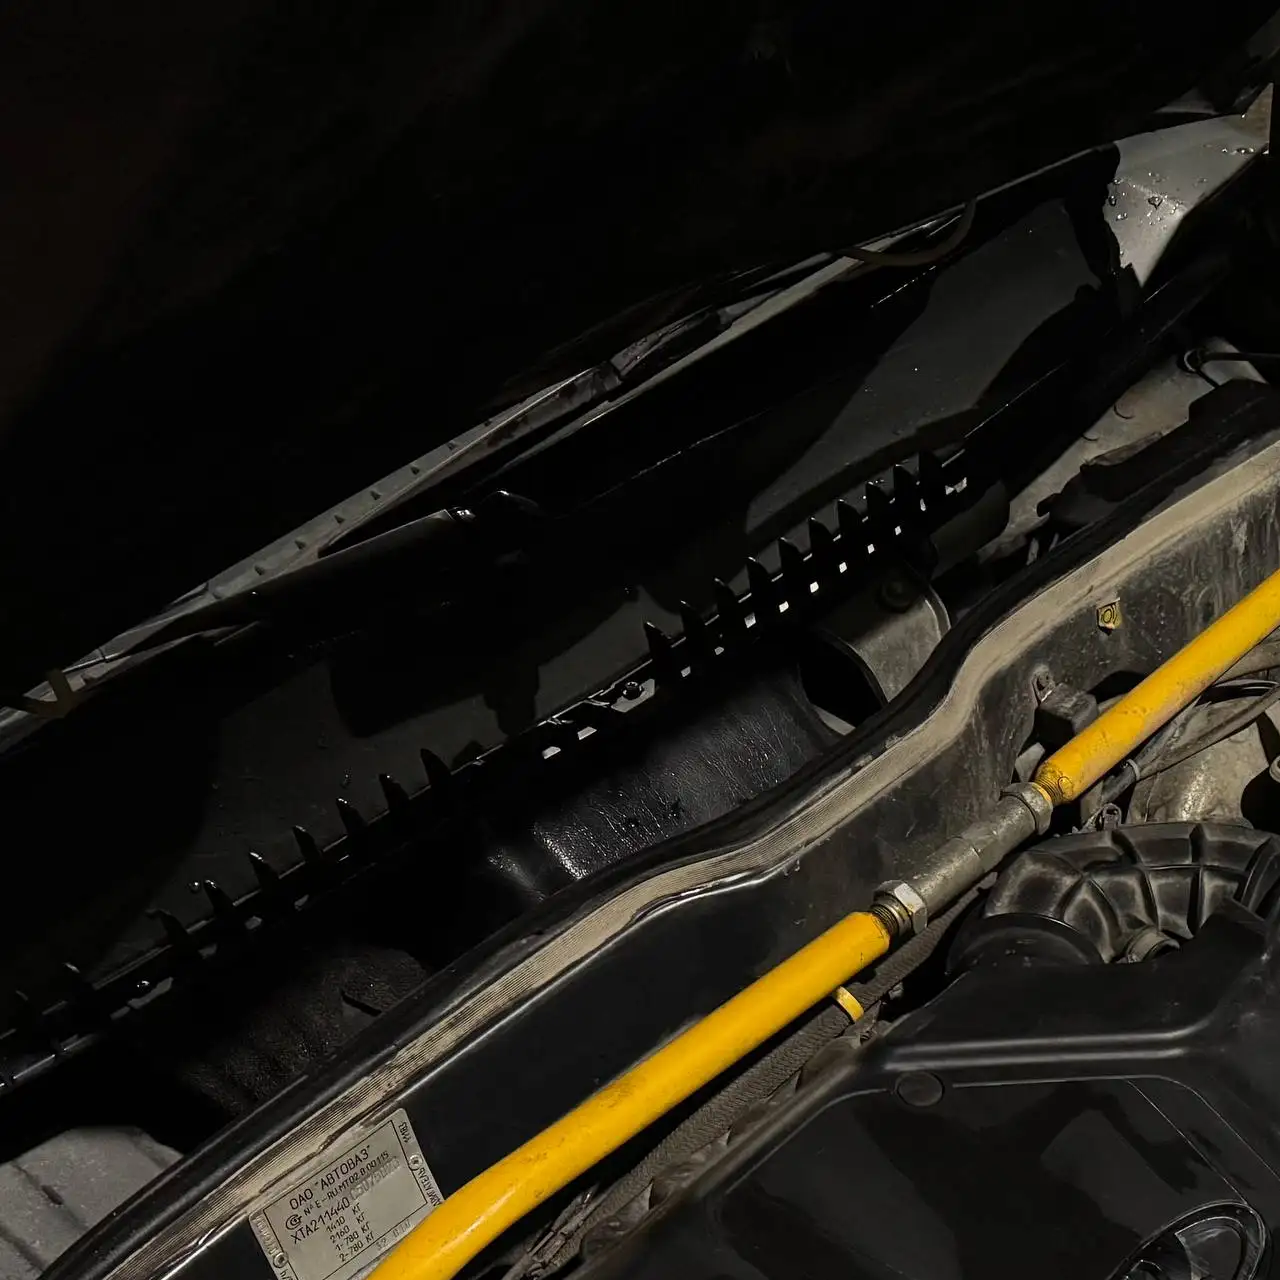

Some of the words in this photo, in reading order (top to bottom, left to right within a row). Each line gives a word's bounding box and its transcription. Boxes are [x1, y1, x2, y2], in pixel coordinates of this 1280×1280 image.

[289, 1187, 314, 1210] ОАО
[291, 1197, 350, 1244] XTA211440
[330, 1225, 350, 1243] 2160
[339, 1243, 364, 1262] 2-780
